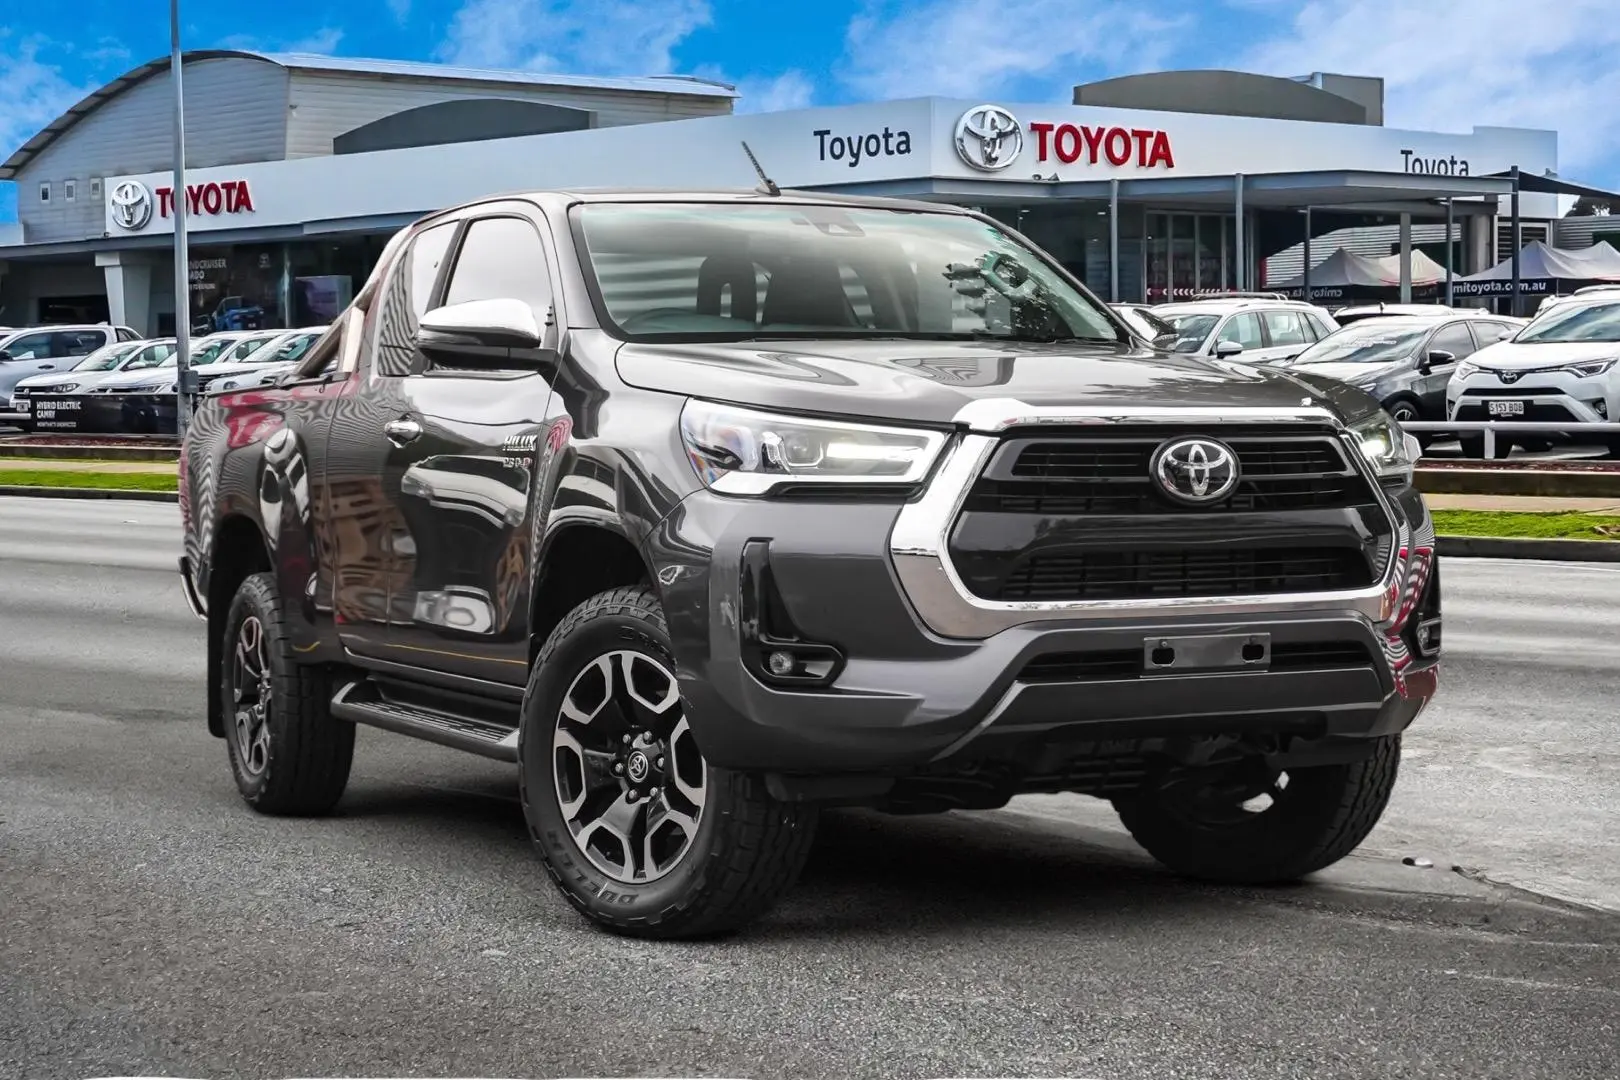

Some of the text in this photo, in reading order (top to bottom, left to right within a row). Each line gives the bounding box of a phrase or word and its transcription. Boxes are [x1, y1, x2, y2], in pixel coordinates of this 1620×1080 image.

[813, 126, 912, 167] Toyota
[1030, 122, 1175, 169] TOYOTA
[57, 401, 81, 410] ELECTRIC
